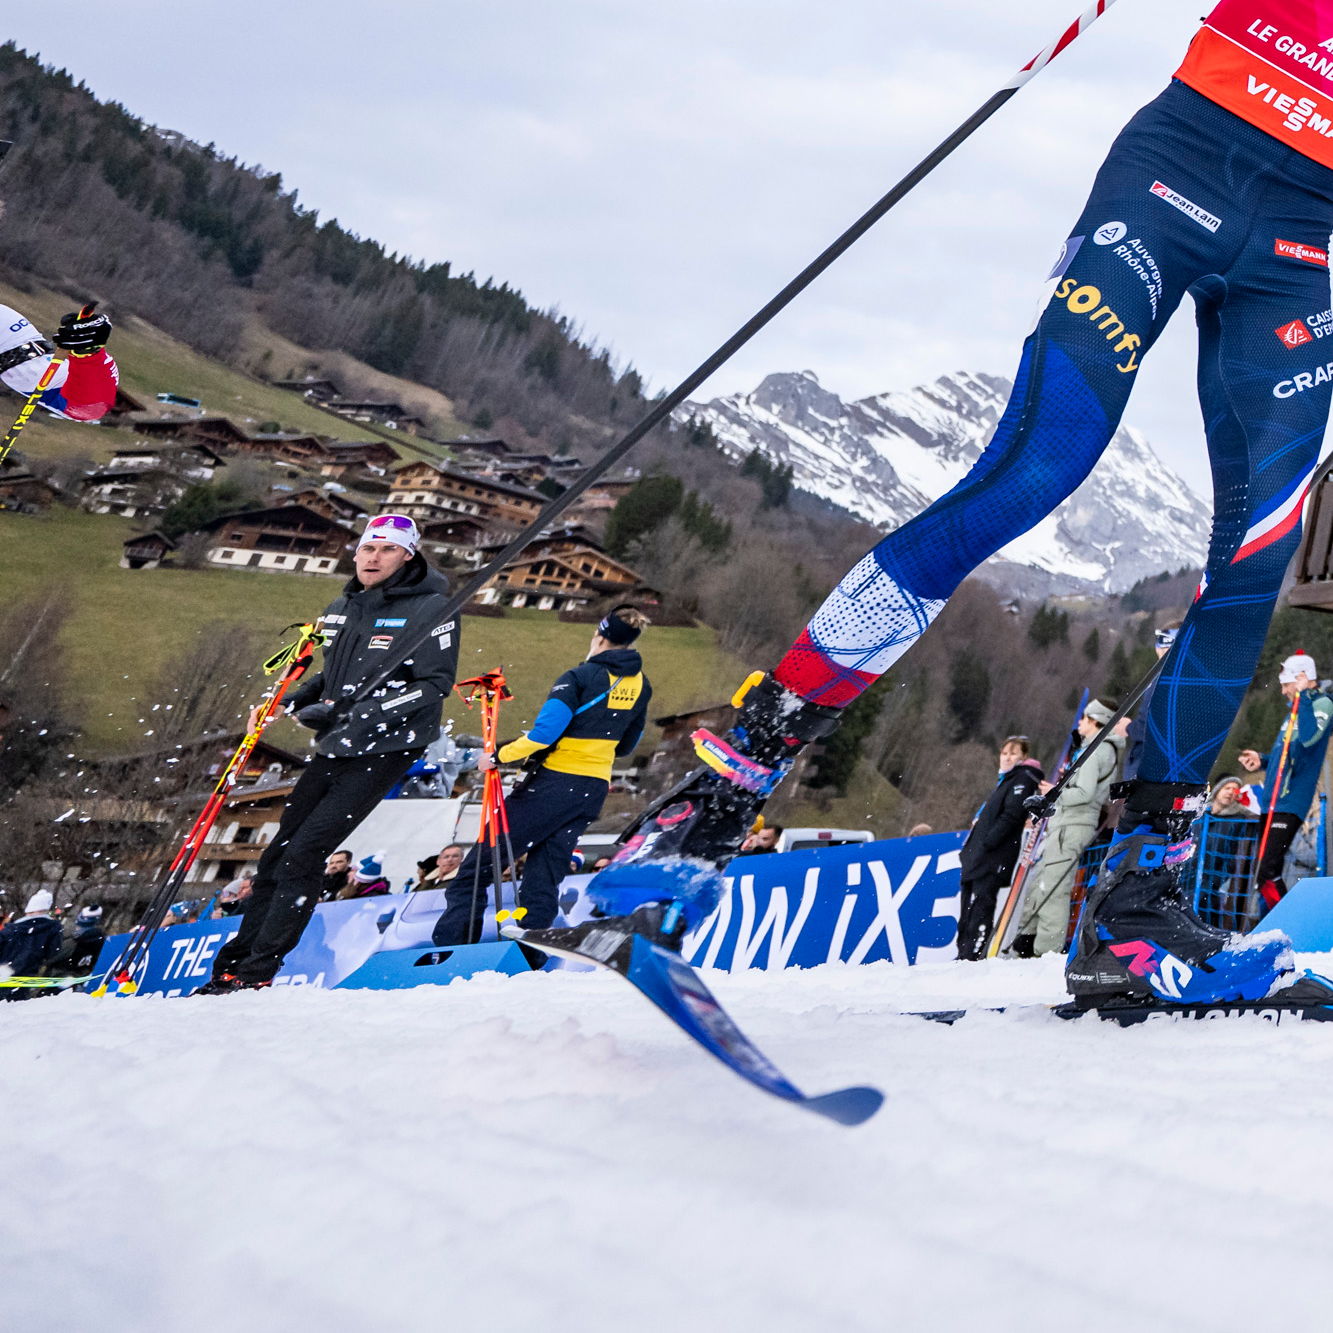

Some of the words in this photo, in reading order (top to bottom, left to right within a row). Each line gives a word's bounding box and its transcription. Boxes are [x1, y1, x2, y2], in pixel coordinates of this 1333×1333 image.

[1247, 19, 1278, 42] LE
[1166, 193, 1194, 212] Jean
[1054, 278, 1142, 373] somfy
[162, 933, 222, 981] THE
